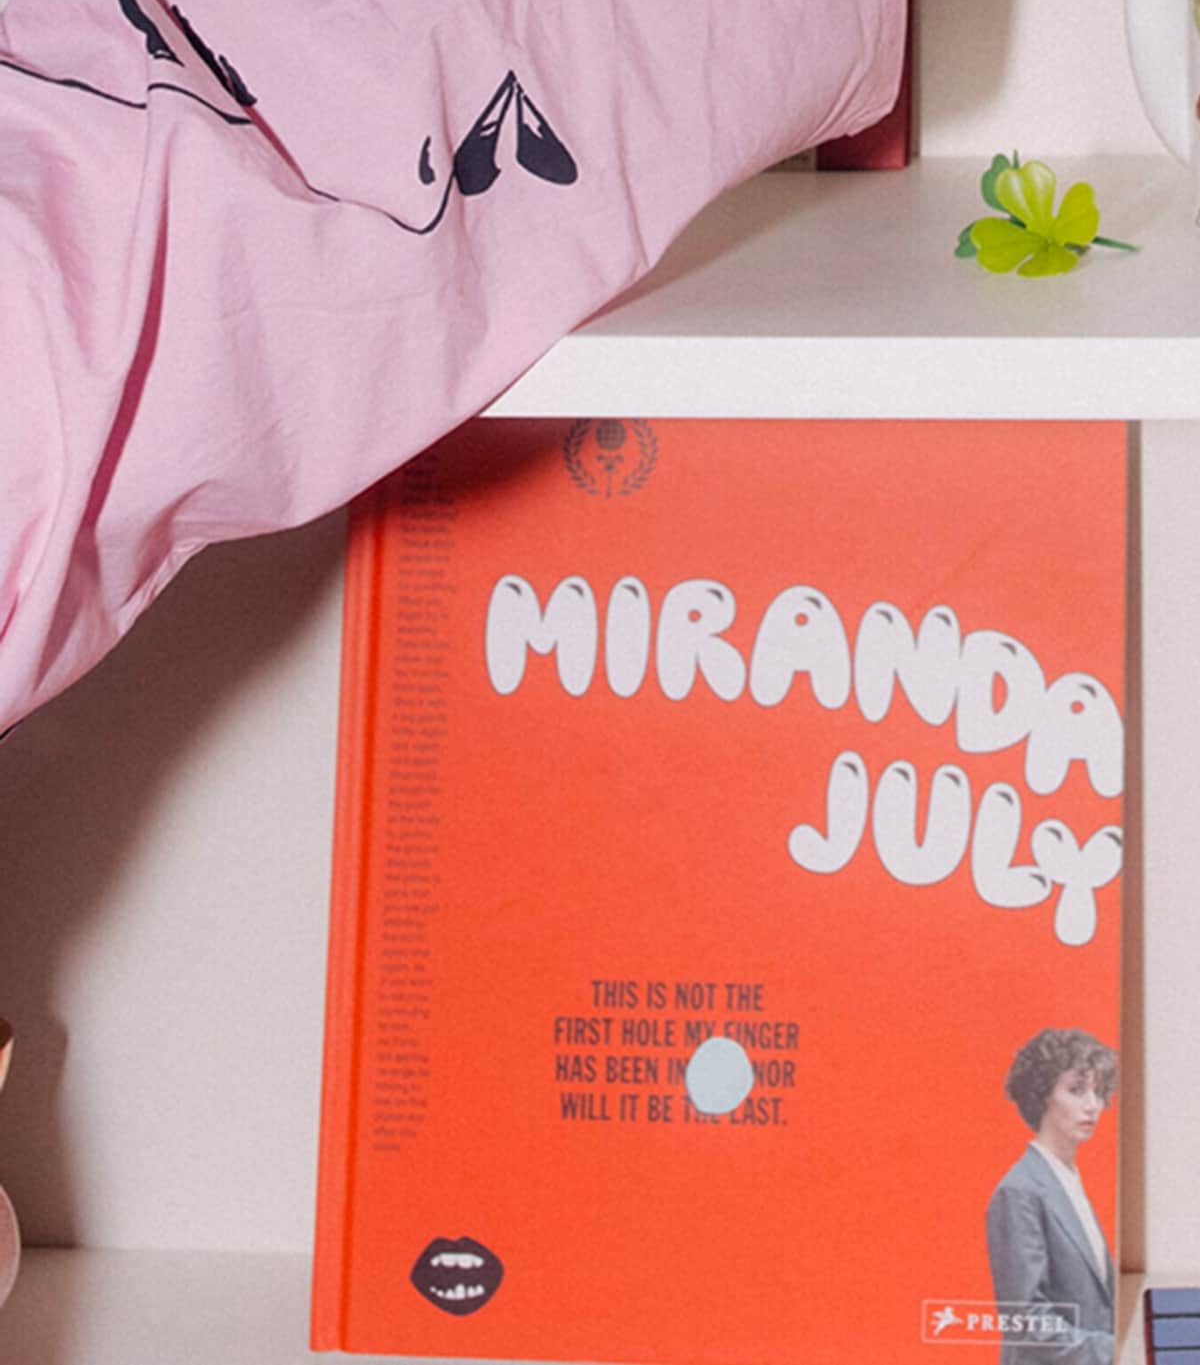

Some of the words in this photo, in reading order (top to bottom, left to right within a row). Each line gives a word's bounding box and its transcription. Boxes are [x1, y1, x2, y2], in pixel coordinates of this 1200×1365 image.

[485, 574, 1125, 798] MIRANDA
[788, 749, 1124, 947] JULY
[592, 980, 640, 1010] THIS
[646, 982, 667, 1010] IS
[674, 983, 719, 1011] NOT
[724, 983, 766, 1012] THE
[553, 1015, 614, 1046] FIRST
[620, 1018, 677, 1048] HOLE
[554, 1054, 599, 1084] HAS
[605, 1056, 660, 1085] BEEN
[559, 1092, 612, 1122] WILL
[618, 1094, 641, 1122] IT
[646, 1095, 674, 1123] BE
[966, 1313, 1069, 1334] PRESTEL
